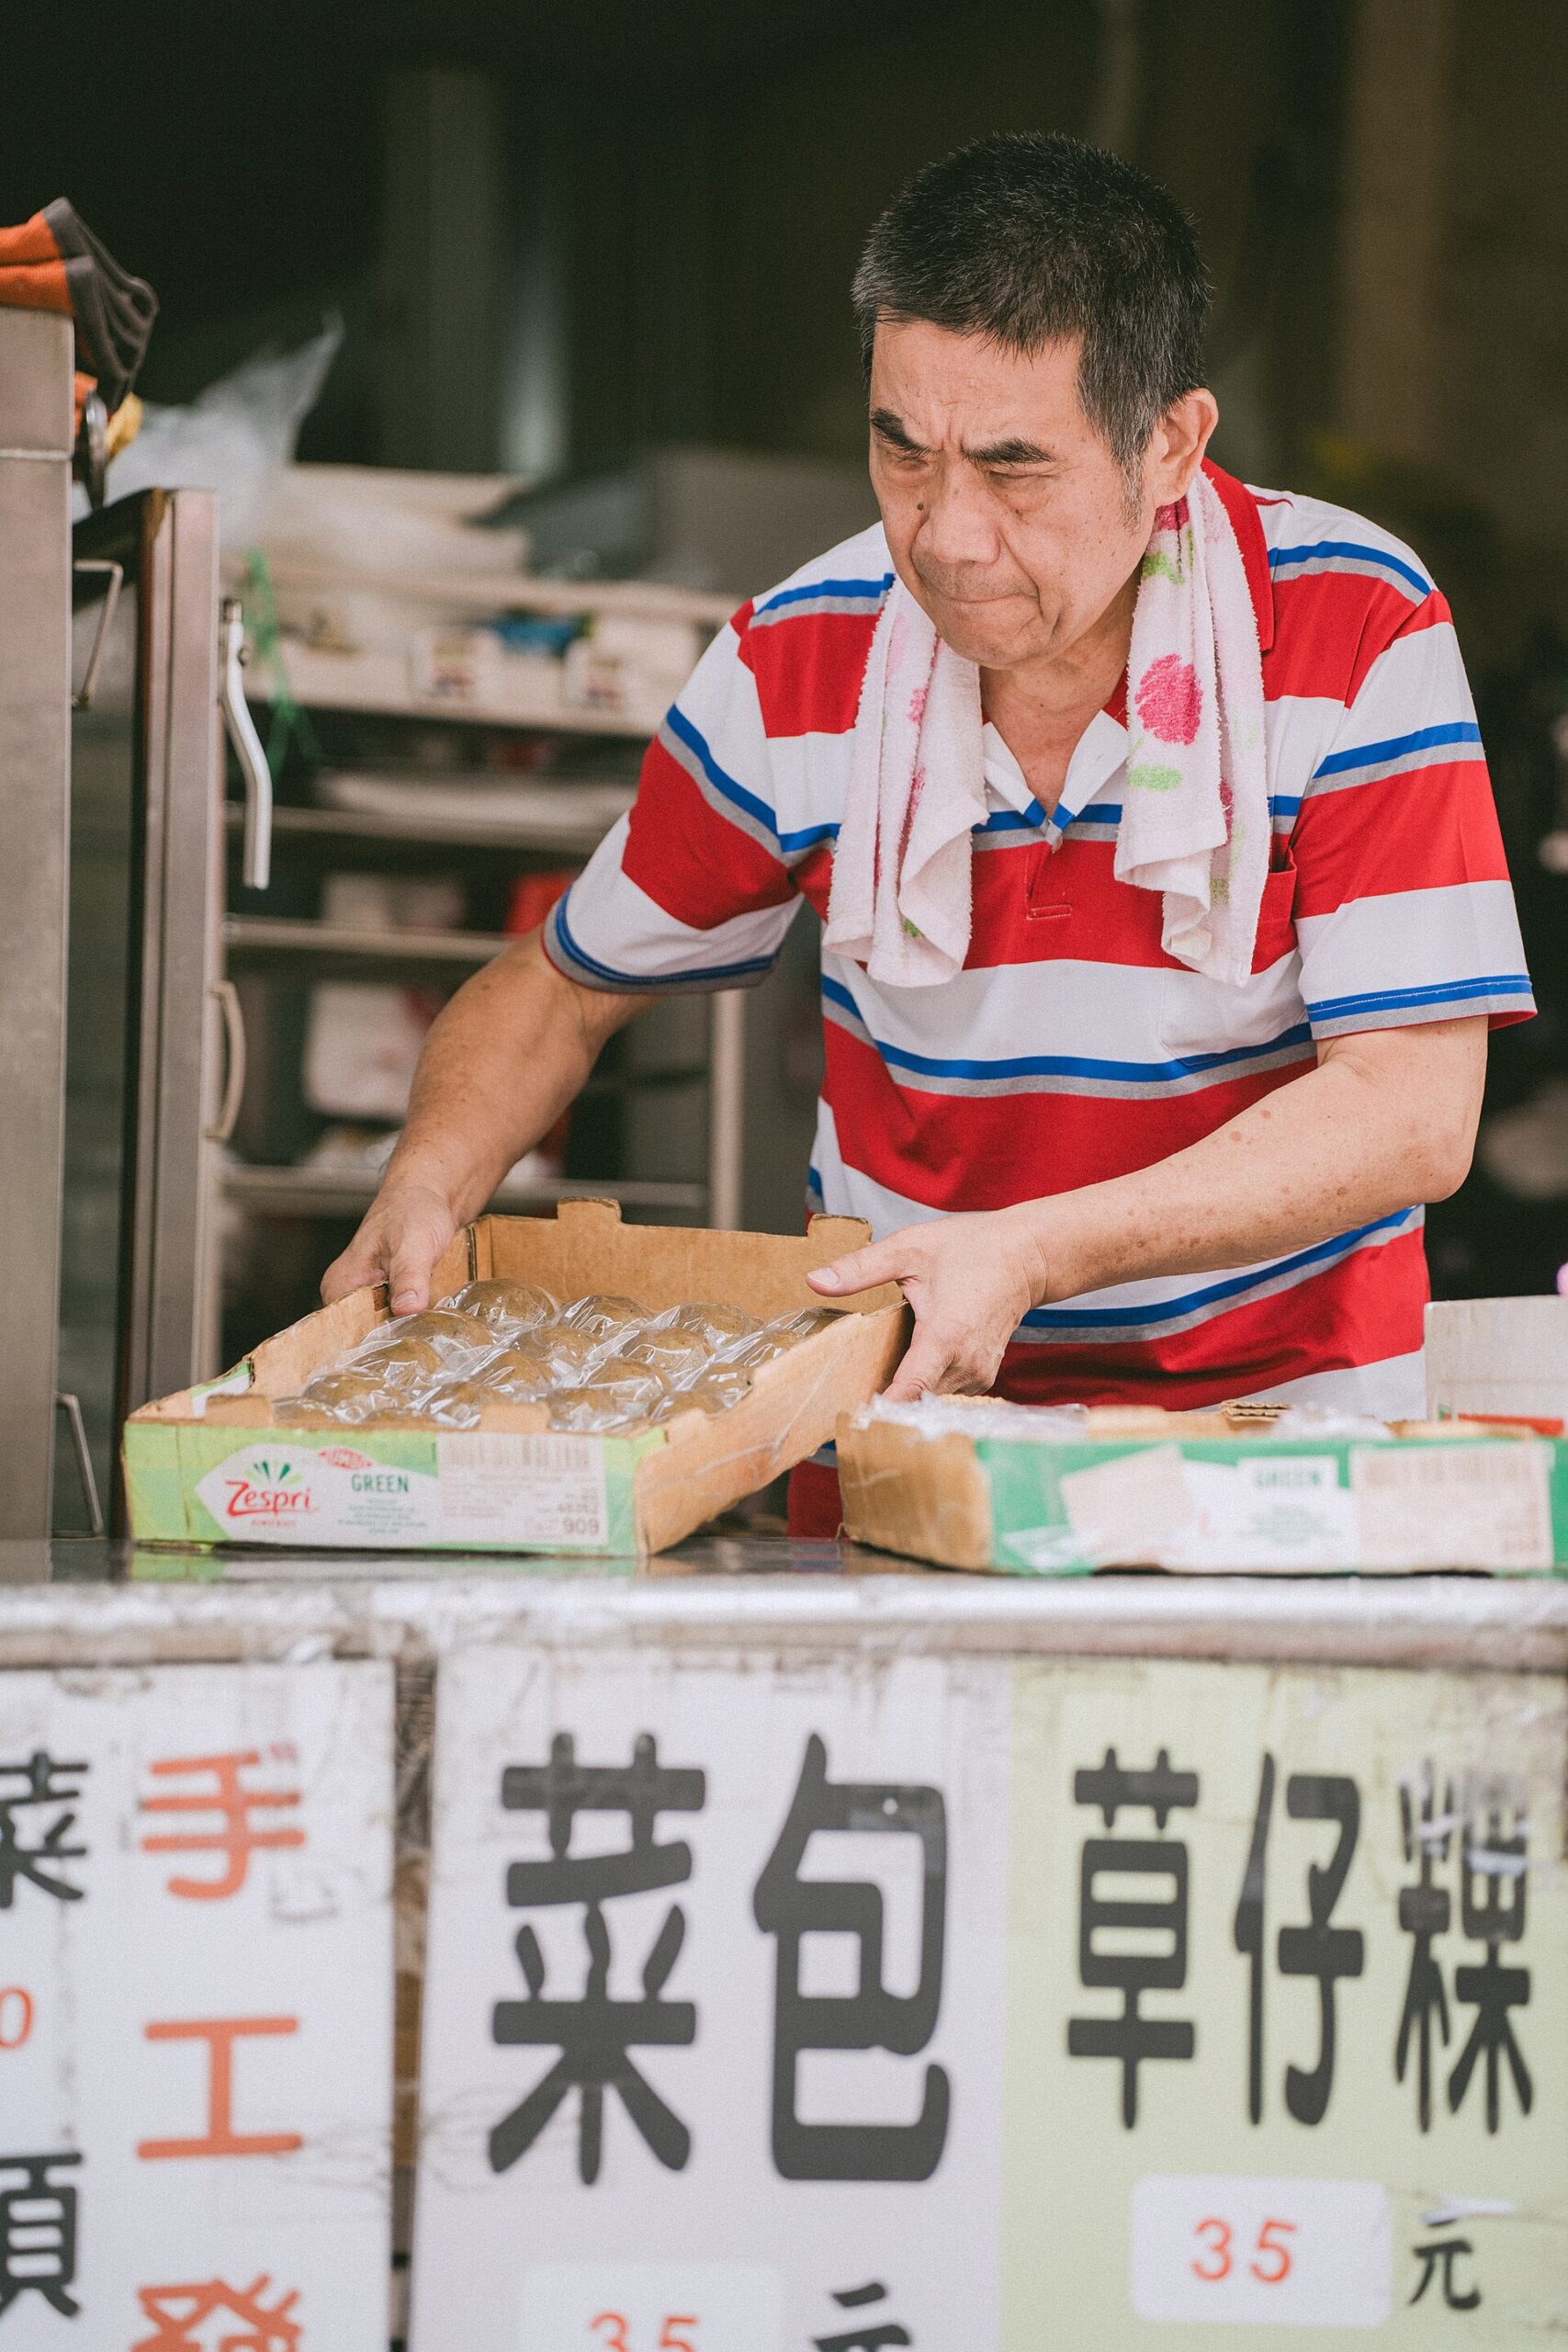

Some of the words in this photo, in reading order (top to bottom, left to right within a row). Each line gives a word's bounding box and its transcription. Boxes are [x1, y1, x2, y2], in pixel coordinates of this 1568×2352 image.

[225, 1479, 314, 1517] Zespri
[351, 1474, 409, 1493] GREEN
[489, 1732, 949, 2185] 菜包
[1066, 1747, 1534, 2135] 草仔粿
[1190, 2218, 1297, 2283] 35
[1409, 2209, 1483, 2311] 元
